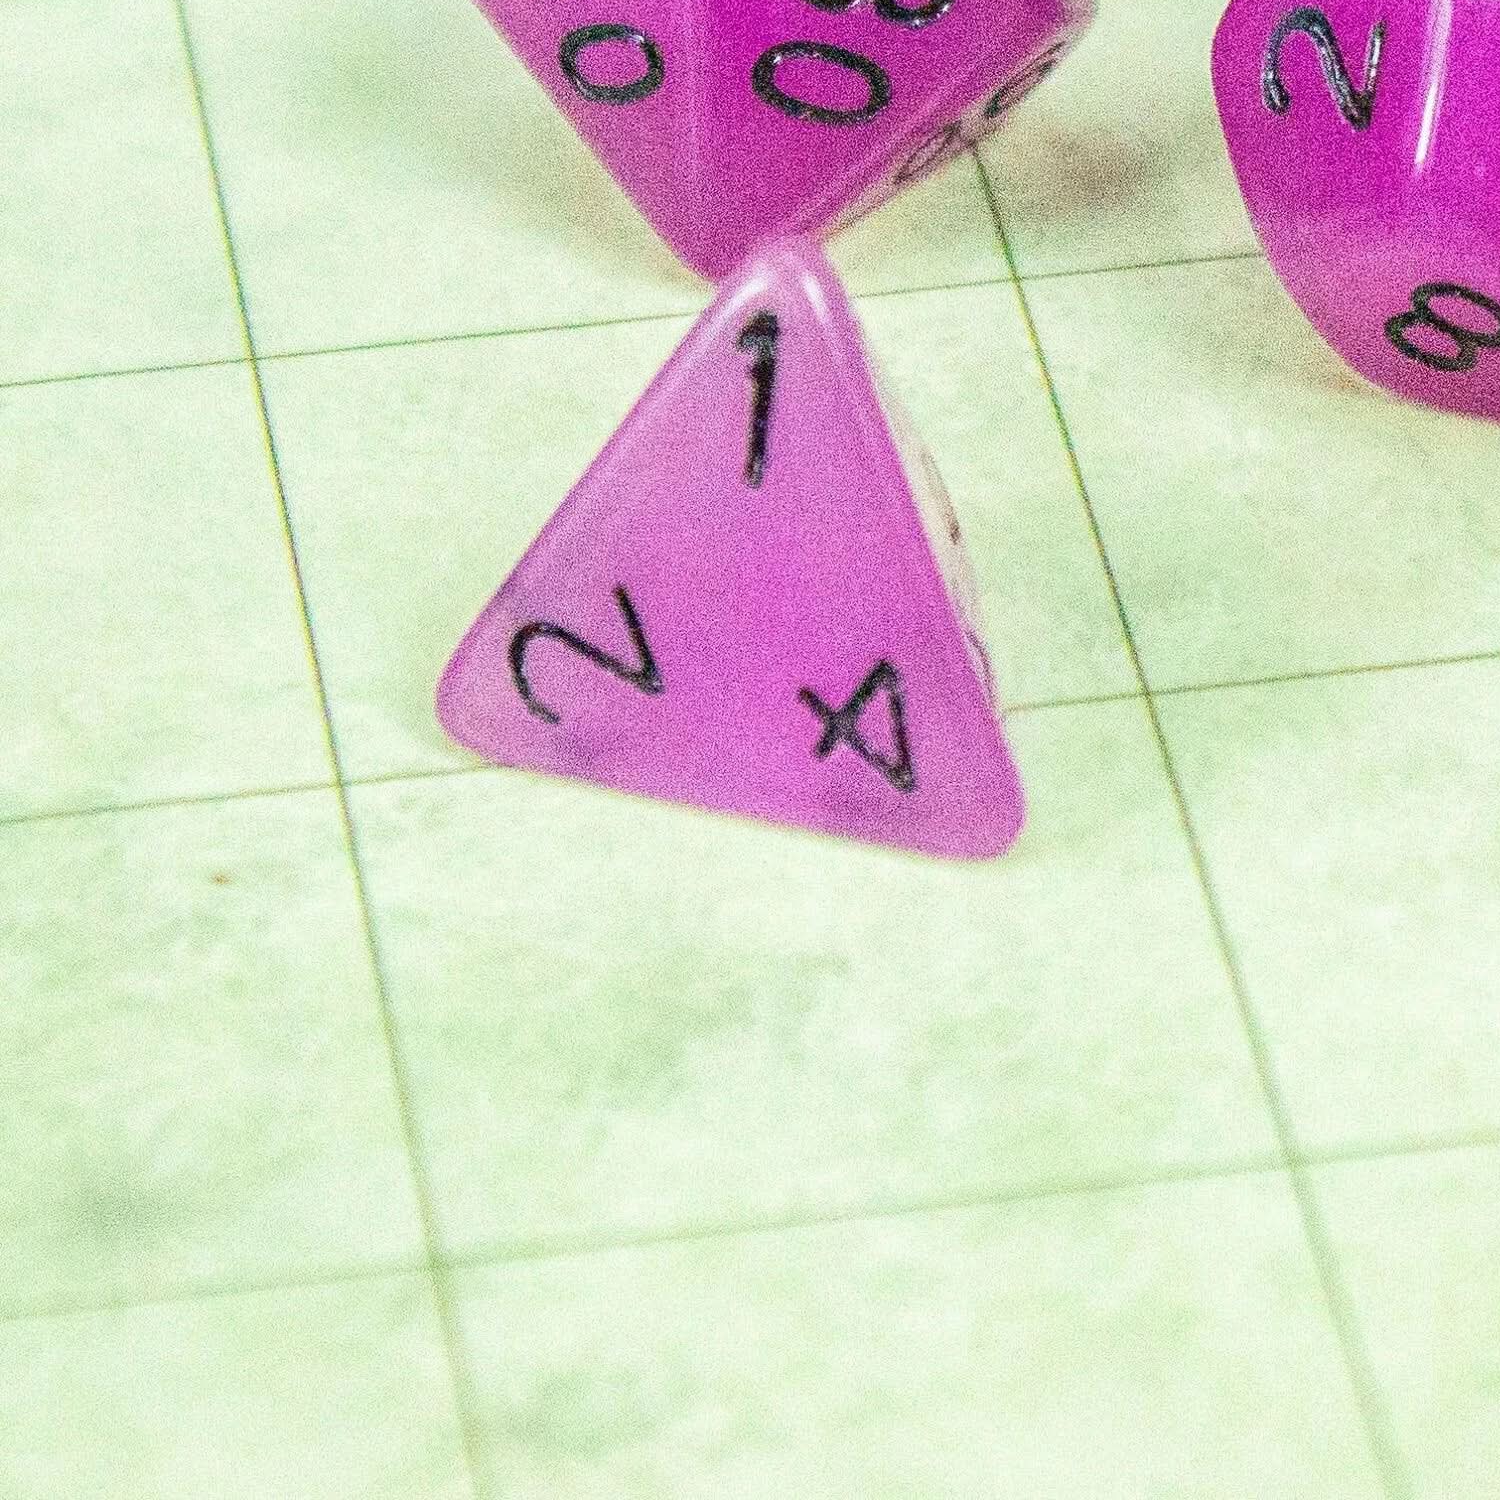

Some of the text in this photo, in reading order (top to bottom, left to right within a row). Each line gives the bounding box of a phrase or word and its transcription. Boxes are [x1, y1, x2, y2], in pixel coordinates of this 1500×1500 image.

[1262, 6, 1386, 132] 2
[738, 310, 780, 490] 1
[506, 582, 666, 724] 2
[800, 658, 918, 792] 4
